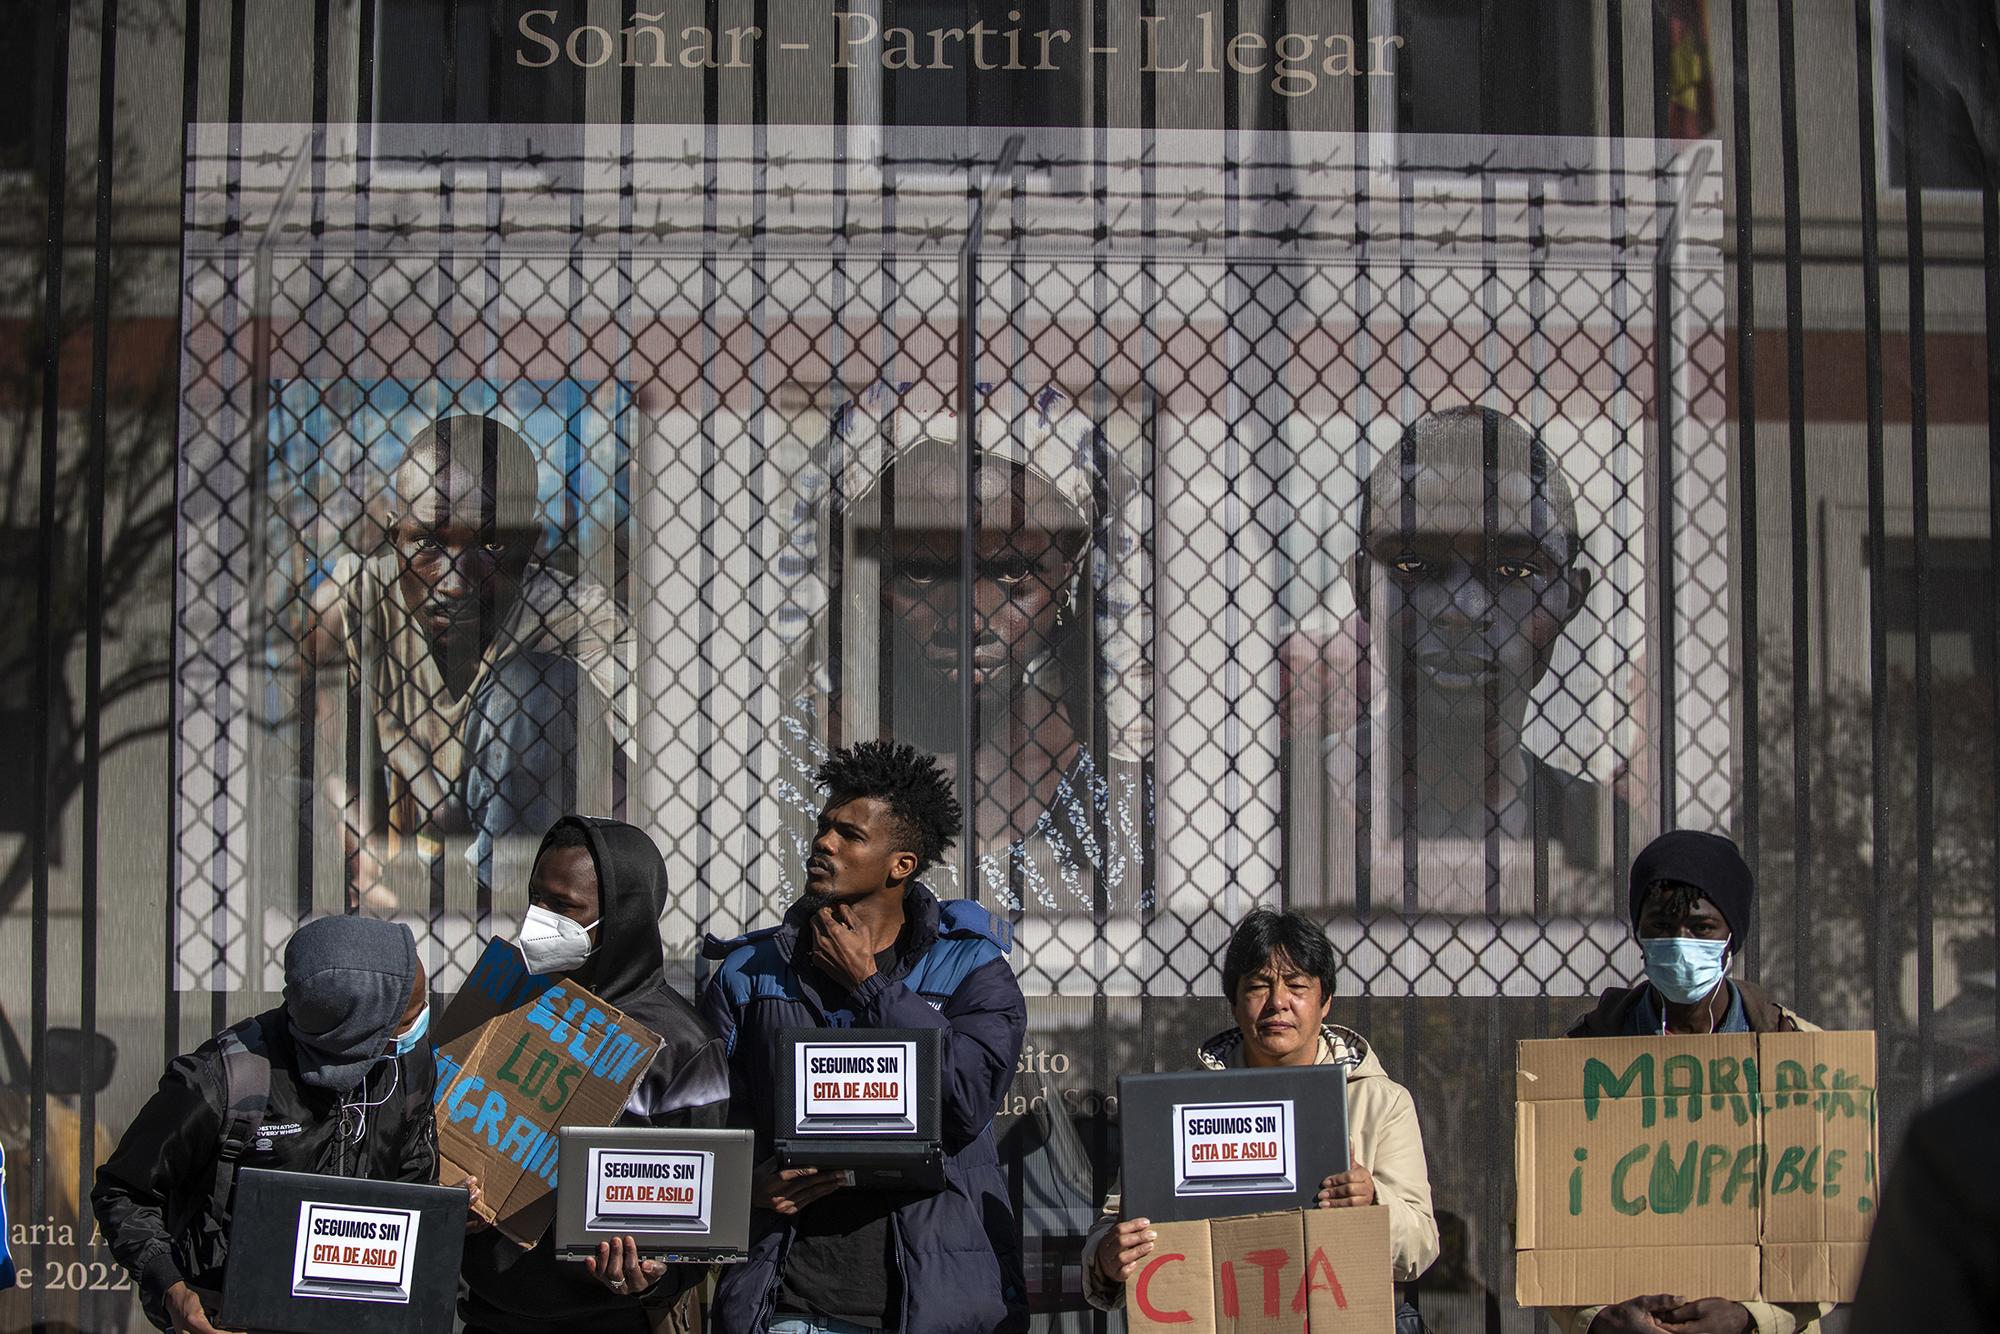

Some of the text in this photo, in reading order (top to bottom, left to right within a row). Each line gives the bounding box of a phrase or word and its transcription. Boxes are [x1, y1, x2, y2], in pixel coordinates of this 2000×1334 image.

[516, 9, 762, 69] Soñar
[831, 9, 1072, 71] Partir
[1139, 11, 1405, 98] Llegar
[496, 1032, 582, 1114] LOS
[810, 1057, 898, 1074] SEGUIMOS SIN
[813, 1082, 899, 1099] CITA DE ASILO
[1188, 1116, 1276, 1136] SEGUIMOS SIN
[1192, 1141, 1278, 1161] CITA DE ASILO
[604, 1162, 695, 1180] SEGUIMOS SIN
[605, 1185, 694, 1203] CITA DE ASILO
[313, 1218, 401, 1242] SEGUIMOS SIN
[313, 1244, 398, 1267] CITA DE ASILO
[44, 1261, 131, 1291] 2022
[1135, 1246, 1348, 1324] CITA
